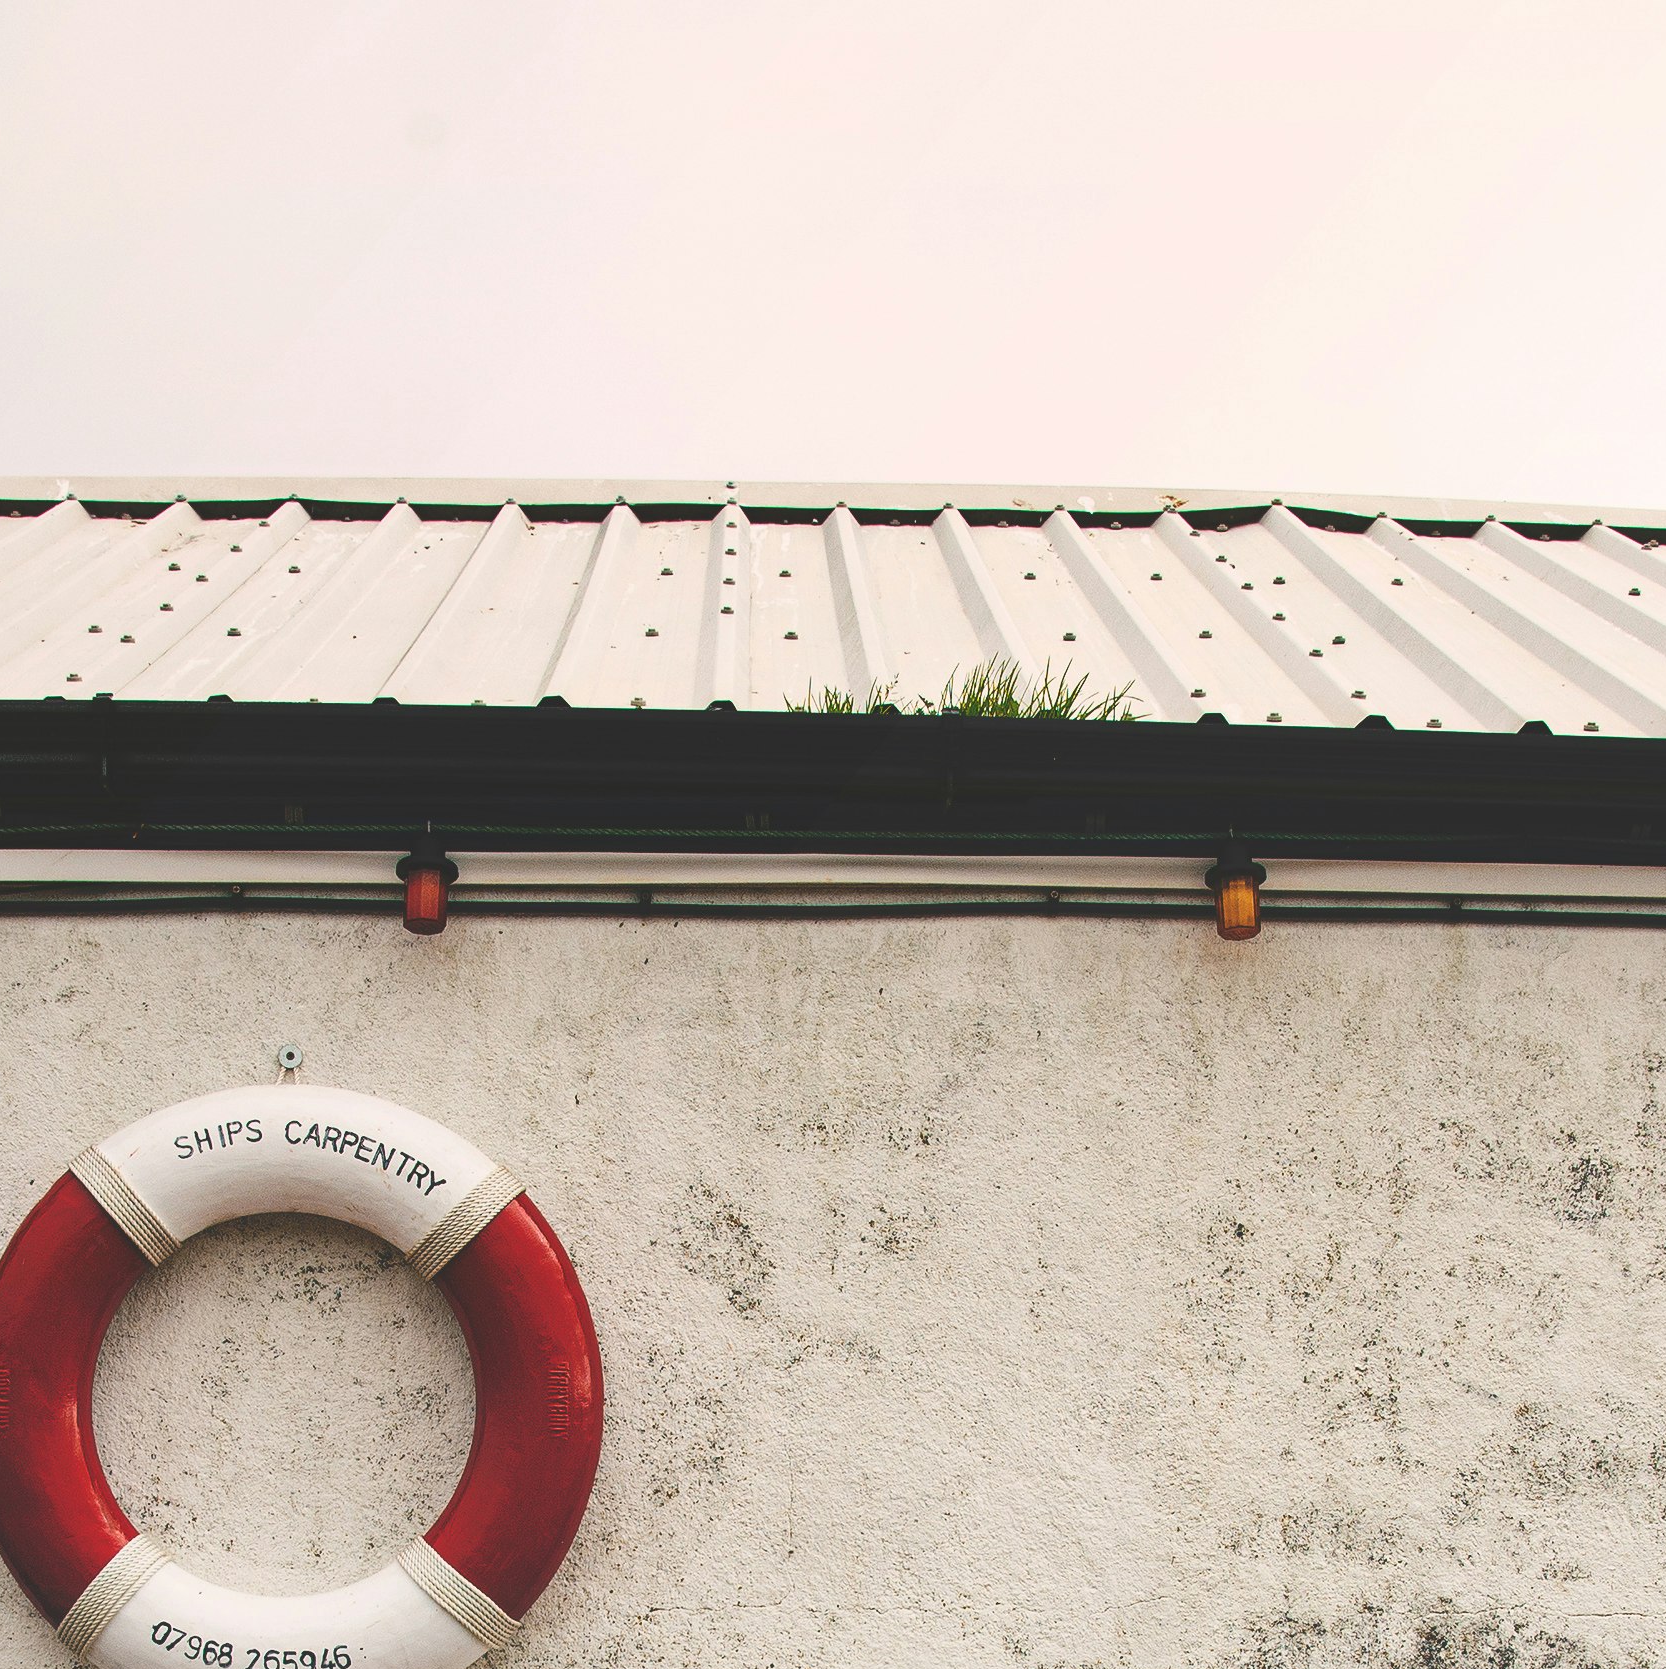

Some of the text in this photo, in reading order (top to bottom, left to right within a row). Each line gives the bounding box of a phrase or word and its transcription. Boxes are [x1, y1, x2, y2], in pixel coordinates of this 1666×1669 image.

[174, 1119, 447, 1196] SHIPS CARPENTRY
[151, 1621, 234, 1668] 07968
